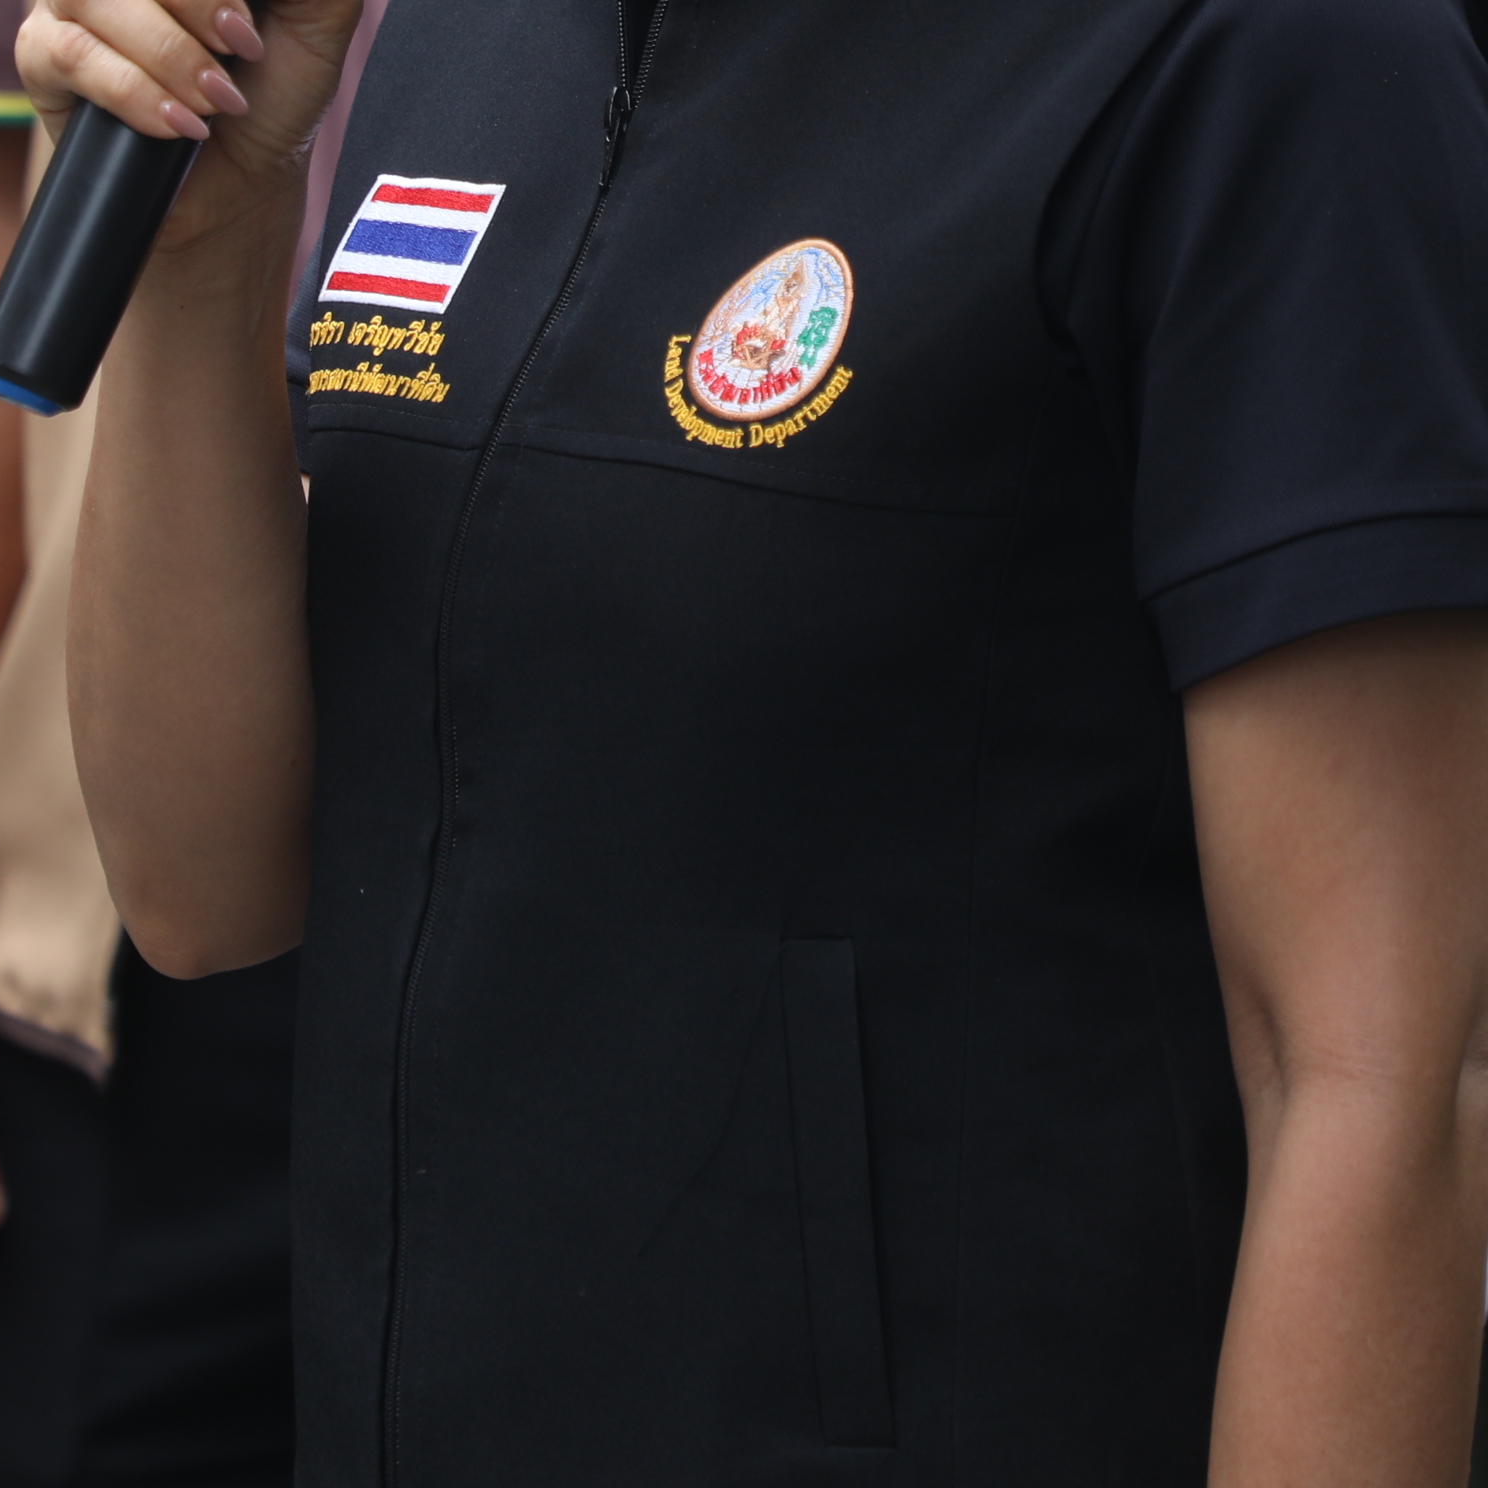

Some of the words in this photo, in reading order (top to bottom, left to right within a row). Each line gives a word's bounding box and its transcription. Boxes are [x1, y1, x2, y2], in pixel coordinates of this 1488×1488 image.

[664, 334, 692, 383] Land
[665, 379, 745, 449] Development
[749, 365, 854, 448] Department
